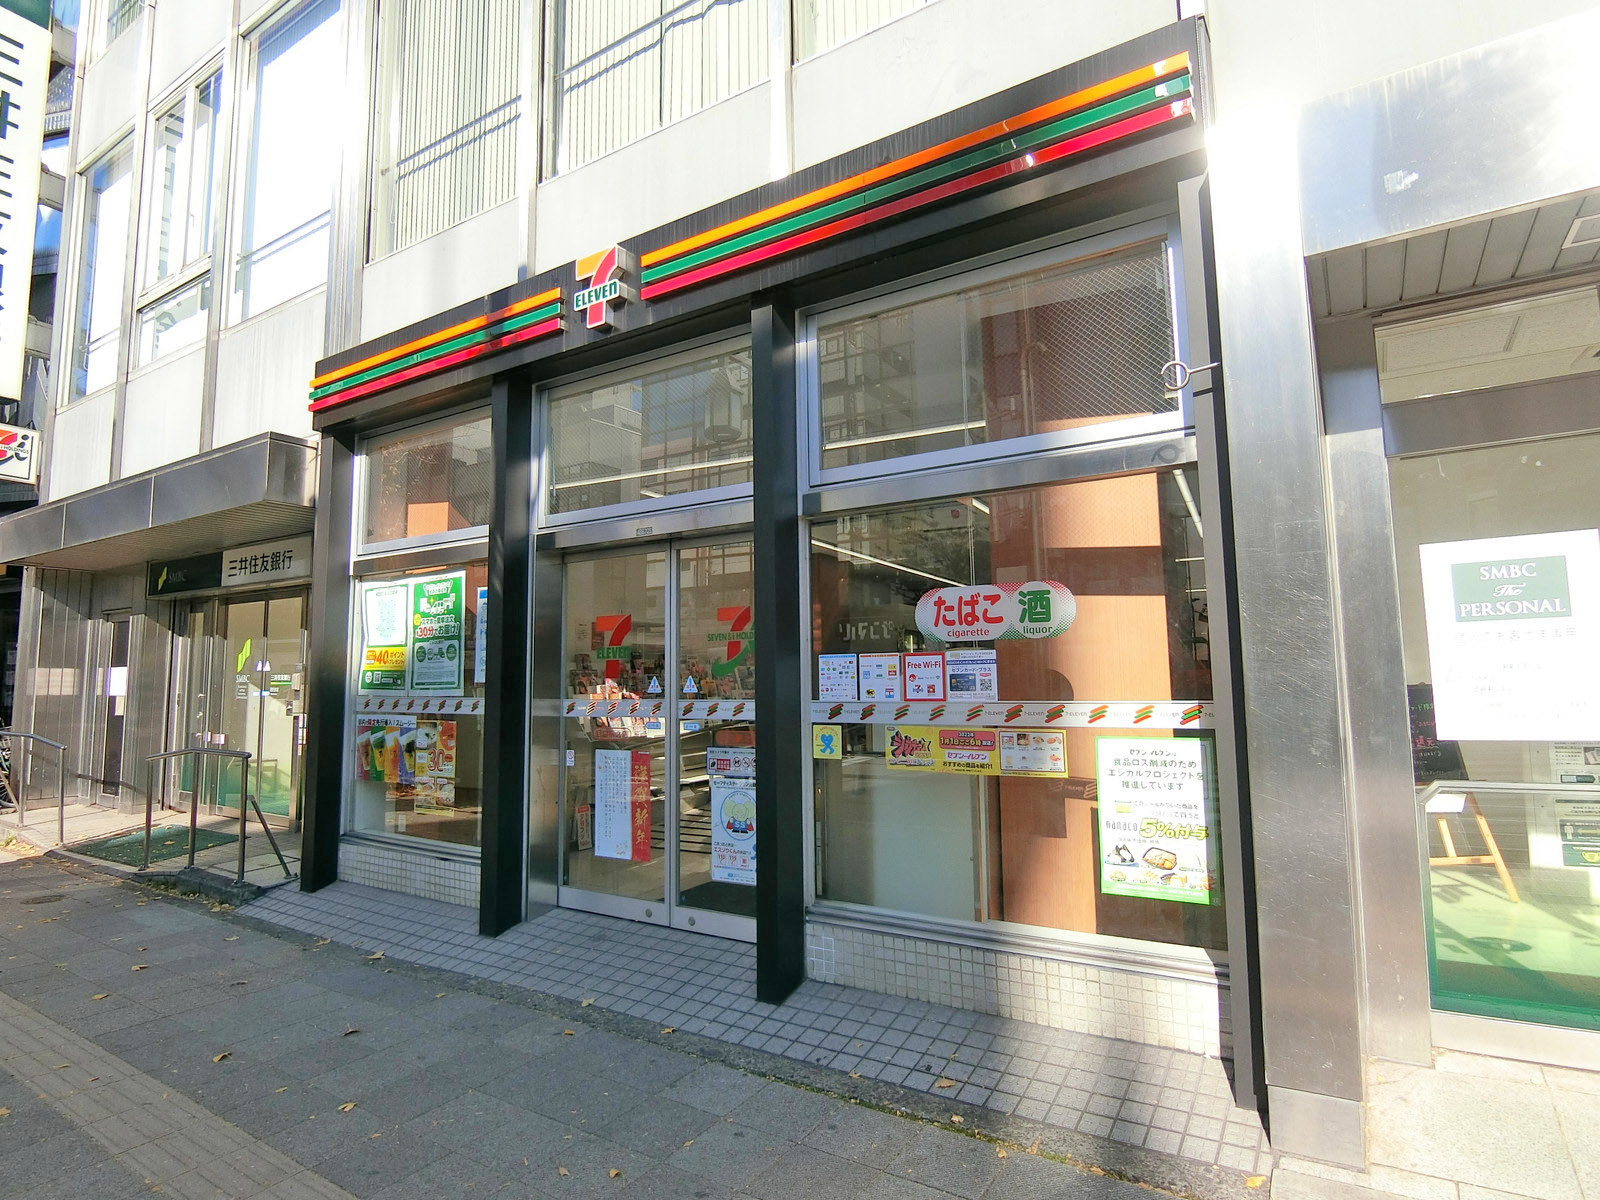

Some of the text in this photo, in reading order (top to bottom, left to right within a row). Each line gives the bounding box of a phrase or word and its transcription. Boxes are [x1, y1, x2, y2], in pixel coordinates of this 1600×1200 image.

[228, 549, 293, 577] 三井住友銀行
[1479, 562, 1537, 581] SMBC
[1493, 582, 1526, 597] The
[933, 589, 1051, 628] たばこ 酒
[1459, 598, 1567, 617] PERSONAL
[947, 625, 1053, 638] cigarette liquor
[908, 661, 921, 669] Free
[1121, 781, 1184, 791] 推進しています
[1139, 817, 1210, 840] 5%付与
